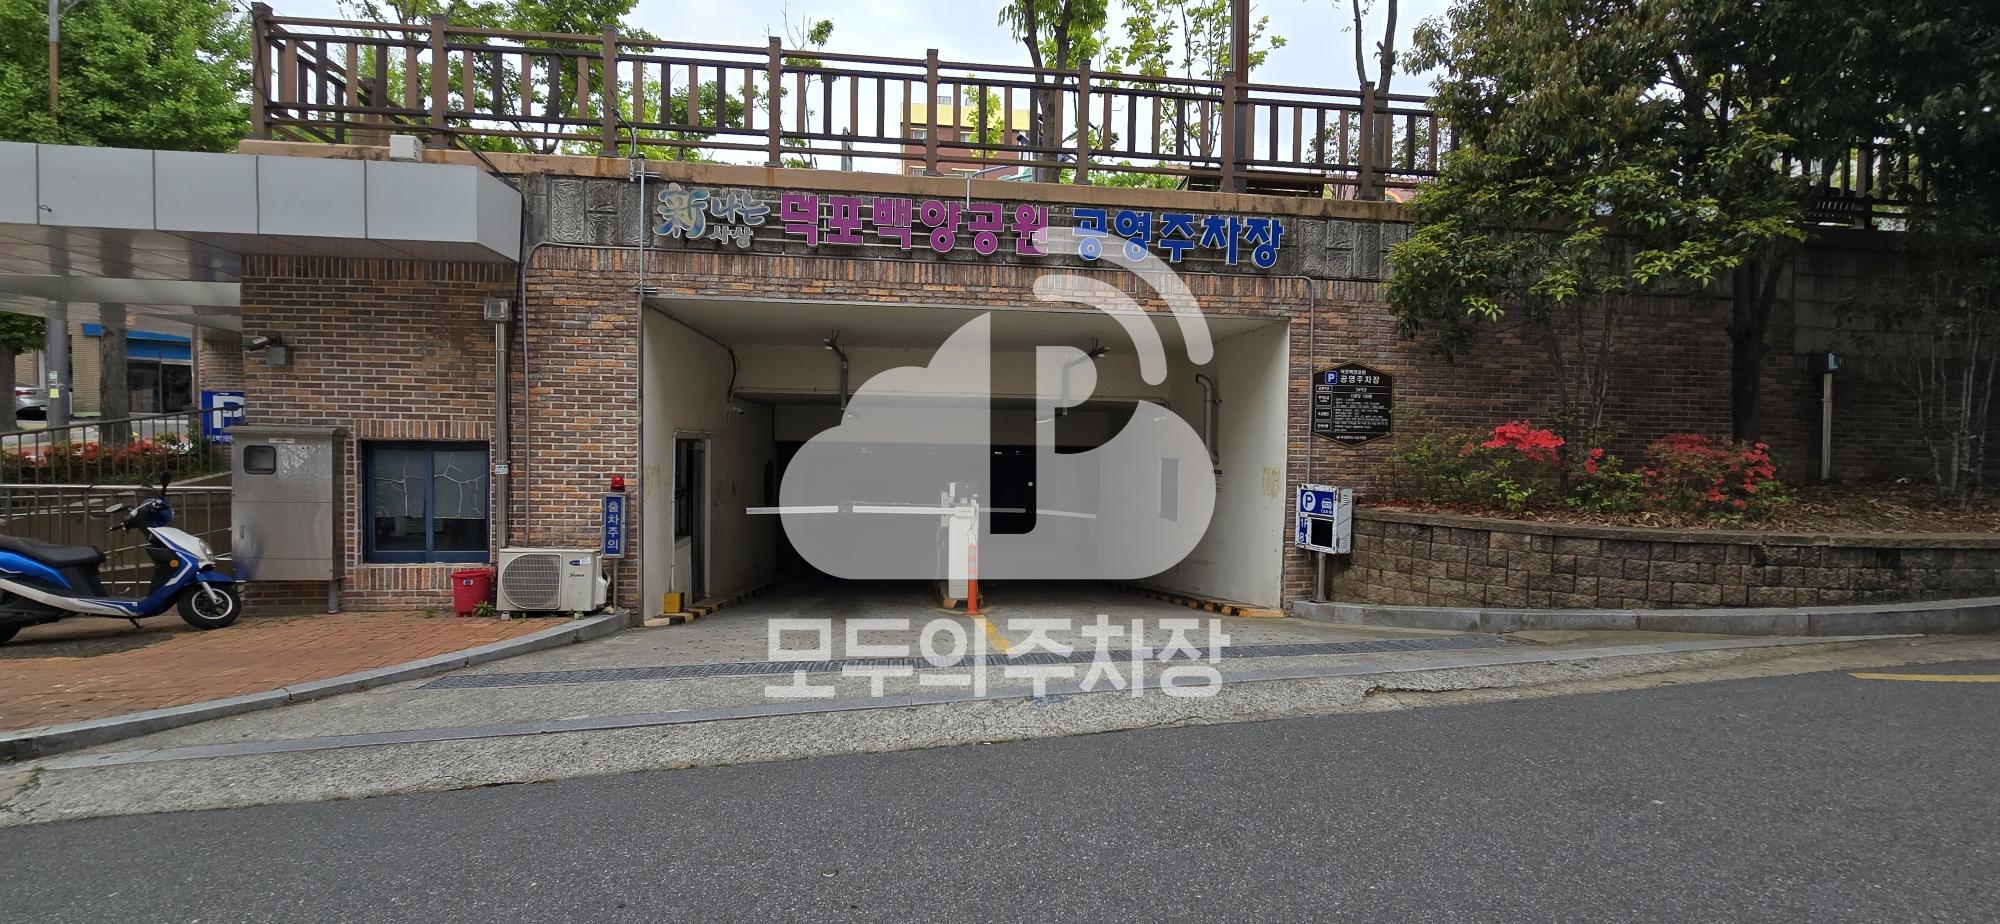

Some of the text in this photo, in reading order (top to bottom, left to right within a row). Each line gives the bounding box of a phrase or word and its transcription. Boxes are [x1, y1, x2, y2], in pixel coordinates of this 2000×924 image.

[708, 225, 754, 249] 사상
[779, 191, 1285, 270] 덕포백양공원 공영주차장
[1327, 373, 1336, 383] P
[212, 395, 246, 429] P
[1305, 493, 1314, 508] P
[606, 501, 620, 551] 출차주의
